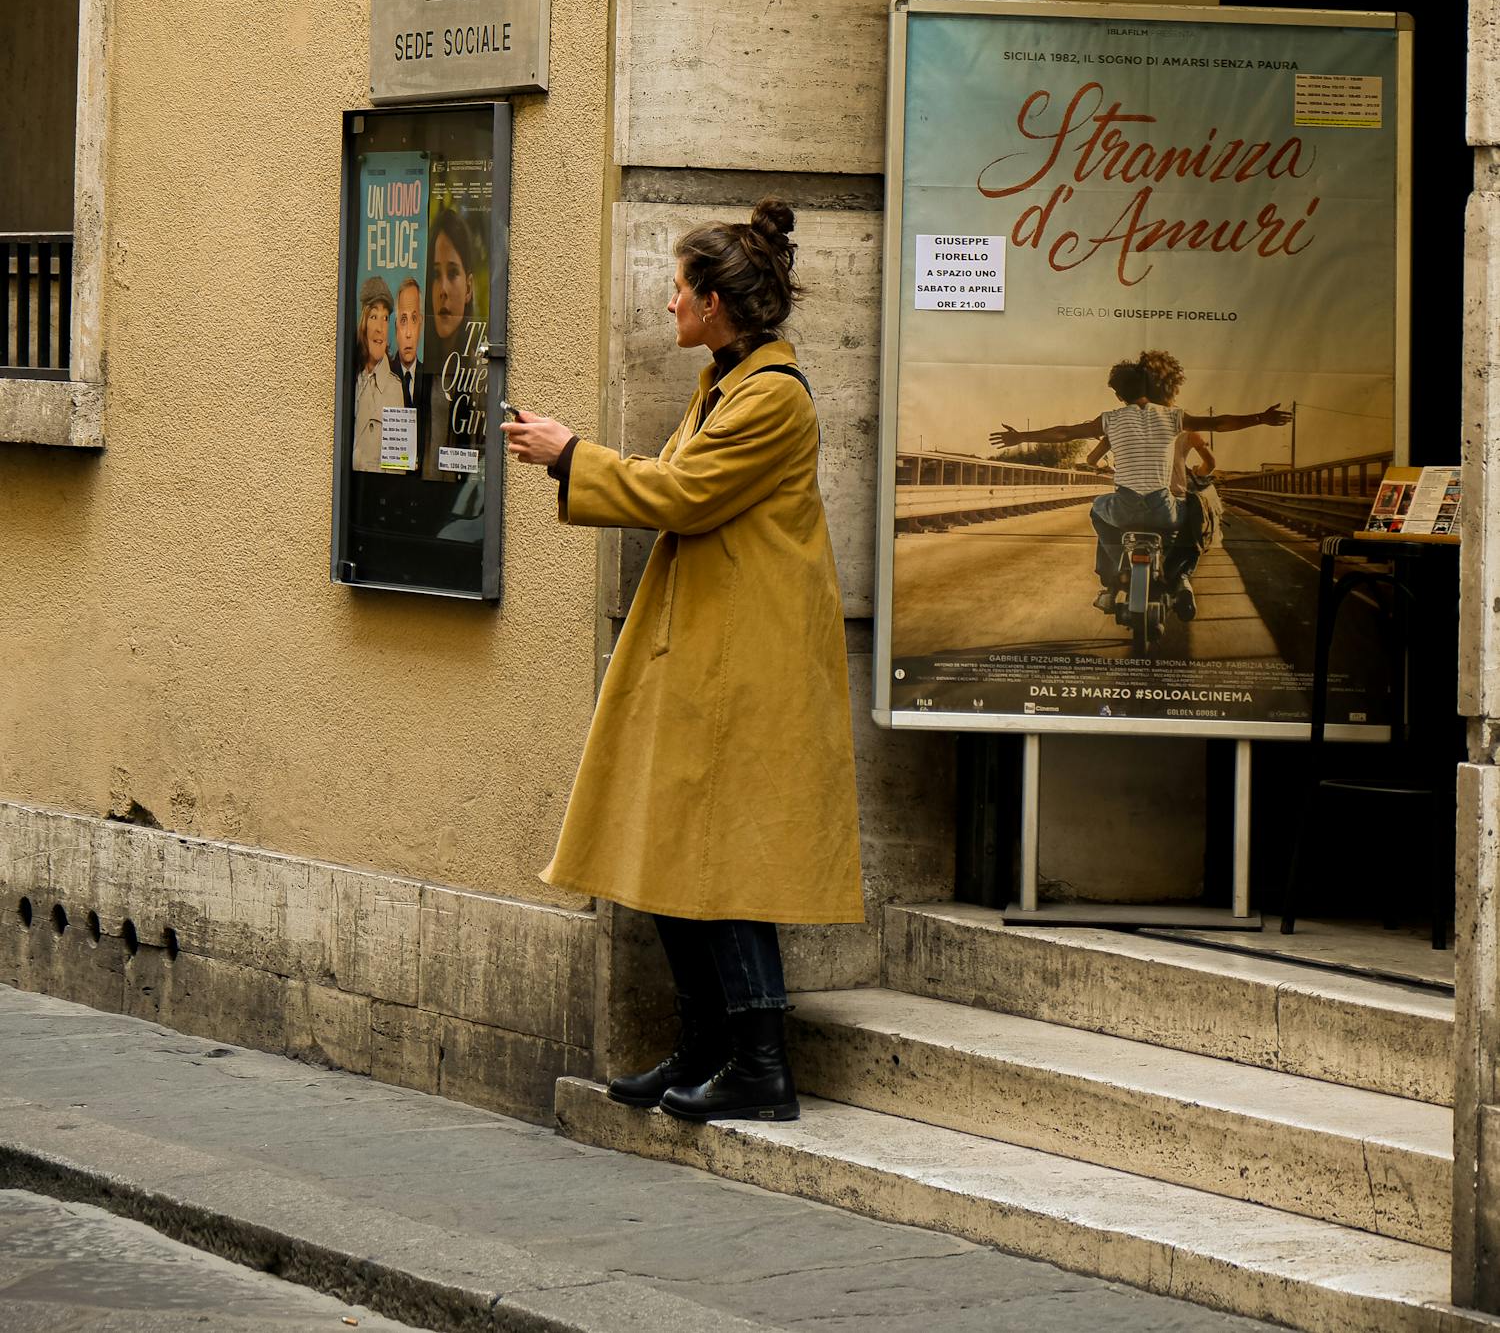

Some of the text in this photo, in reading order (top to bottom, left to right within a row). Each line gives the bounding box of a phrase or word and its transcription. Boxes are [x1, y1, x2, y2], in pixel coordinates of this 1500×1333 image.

[394, 23, 511, 61] SEDE SOCIALE
[1003, 51, 1299, 70] SICILIA 1982, IL SOGNO DI AMARSI SENZA PAURA
[977, 81, 1316, 198] Stranizza
[367, 184, 384, 220] UN
[387, 179, 421, 217] UOMO
[367, 220, 418, 271] FELICE
[934, 237, 989, 245] GIUSEPPE
[935, 253, 988, 261] FIORELLO
[926, 269, 934, 277] A
[936, 269, 972, 277] SPAZIO
[1057, 307, 1238, 322] REGIA DI GIUSEPPE FIORELLO
[461, 321, 488, 357] Th
[441, 351, 488, 401] Quie
[989, 655, 1029, 663] GABRIELE
[1031, 656, 1071, 664] PIZZURRO
[1075, 657, 1113, 665] SAMUELE
[1114, 658, 1151, 666] SEGRETO
[1156, 659, 1187, 667] SIMONA
[1189, 660, 1222, 668] MALATO
[1030, 686, 1252, 702] DAL 23 MARZO #SOLOALCINEMA
